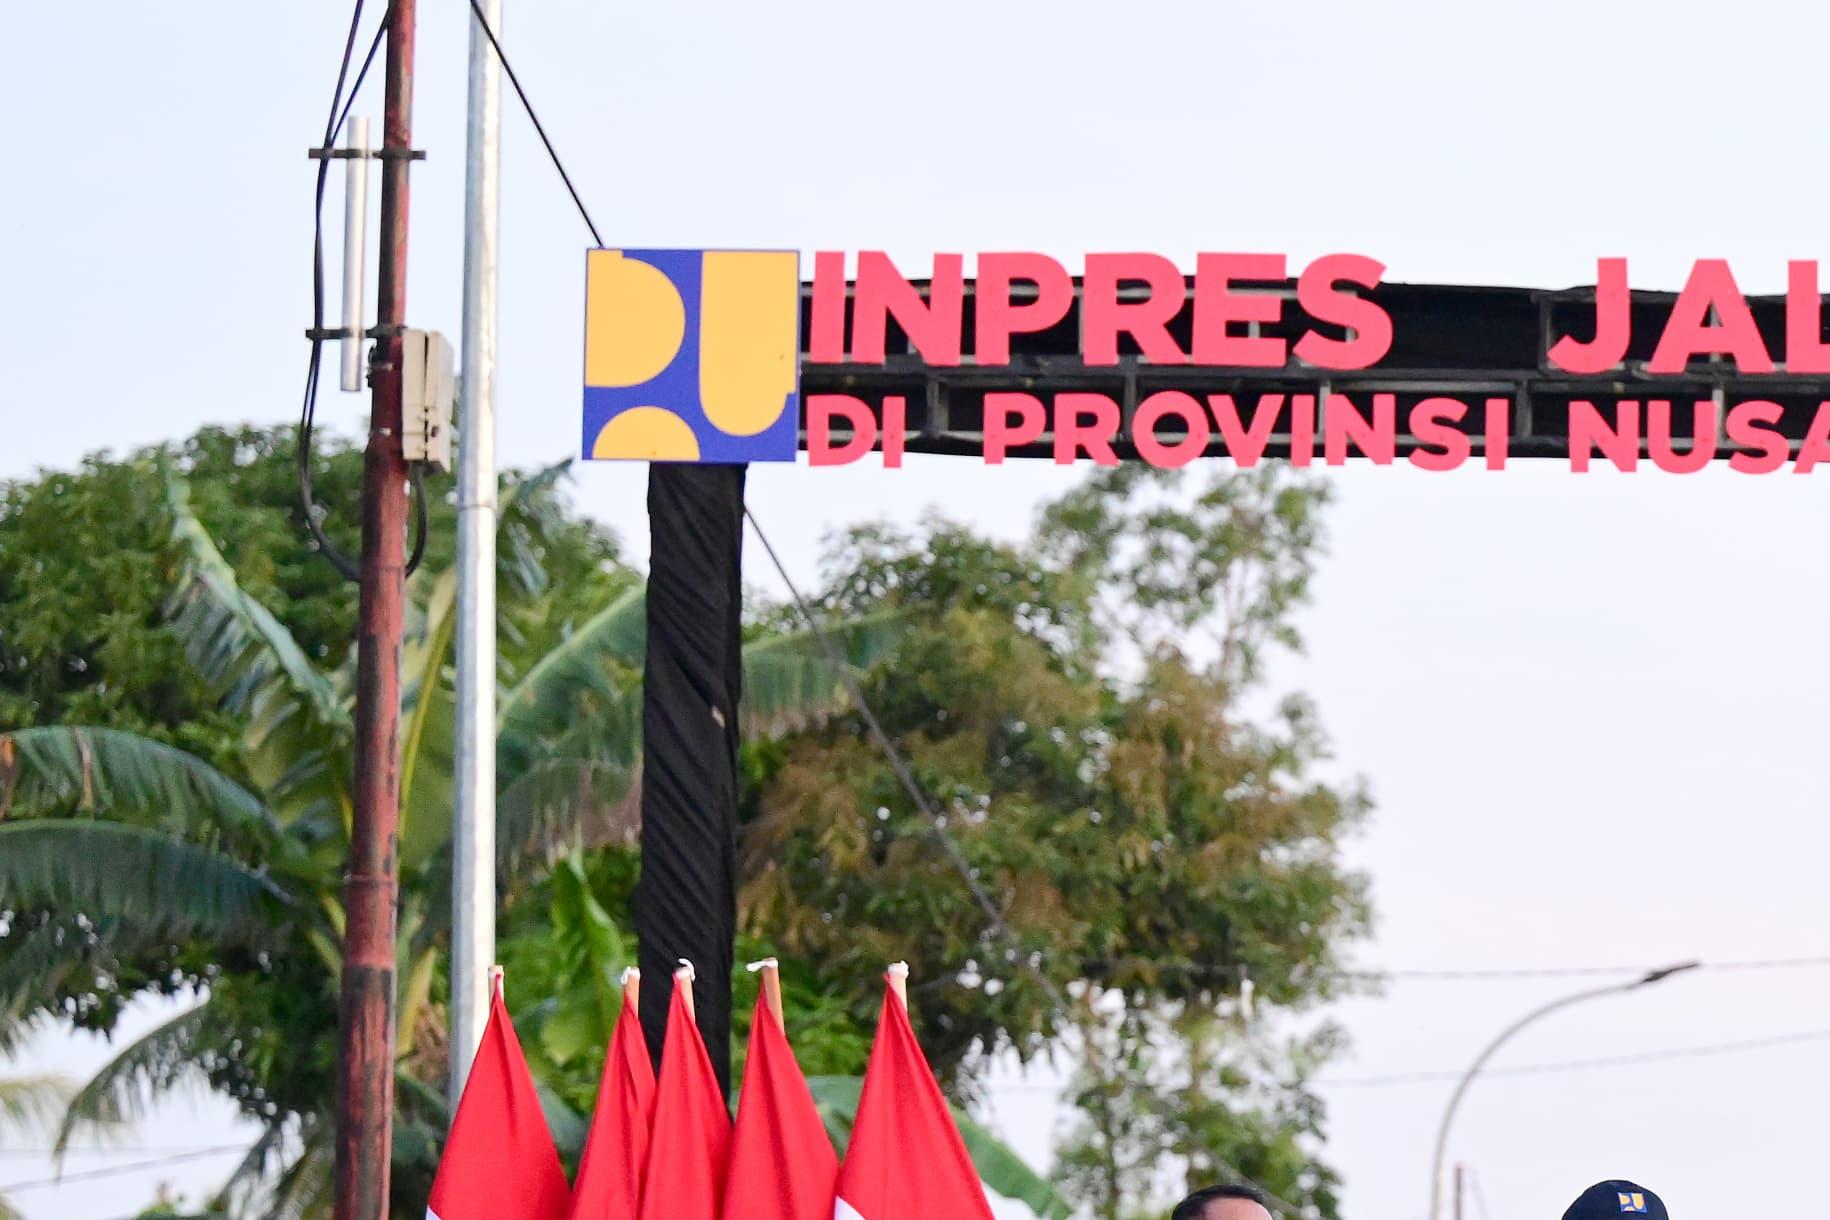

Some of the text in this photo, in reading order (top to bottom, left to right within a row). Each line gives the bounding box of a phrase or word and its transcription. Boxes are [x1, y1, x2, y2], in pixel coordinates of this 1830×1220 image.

[809, 251, 1394, 371] INPRES
[805, 394, 906, 468] DI
[982, 390, 1509, 471] PROVINSI
